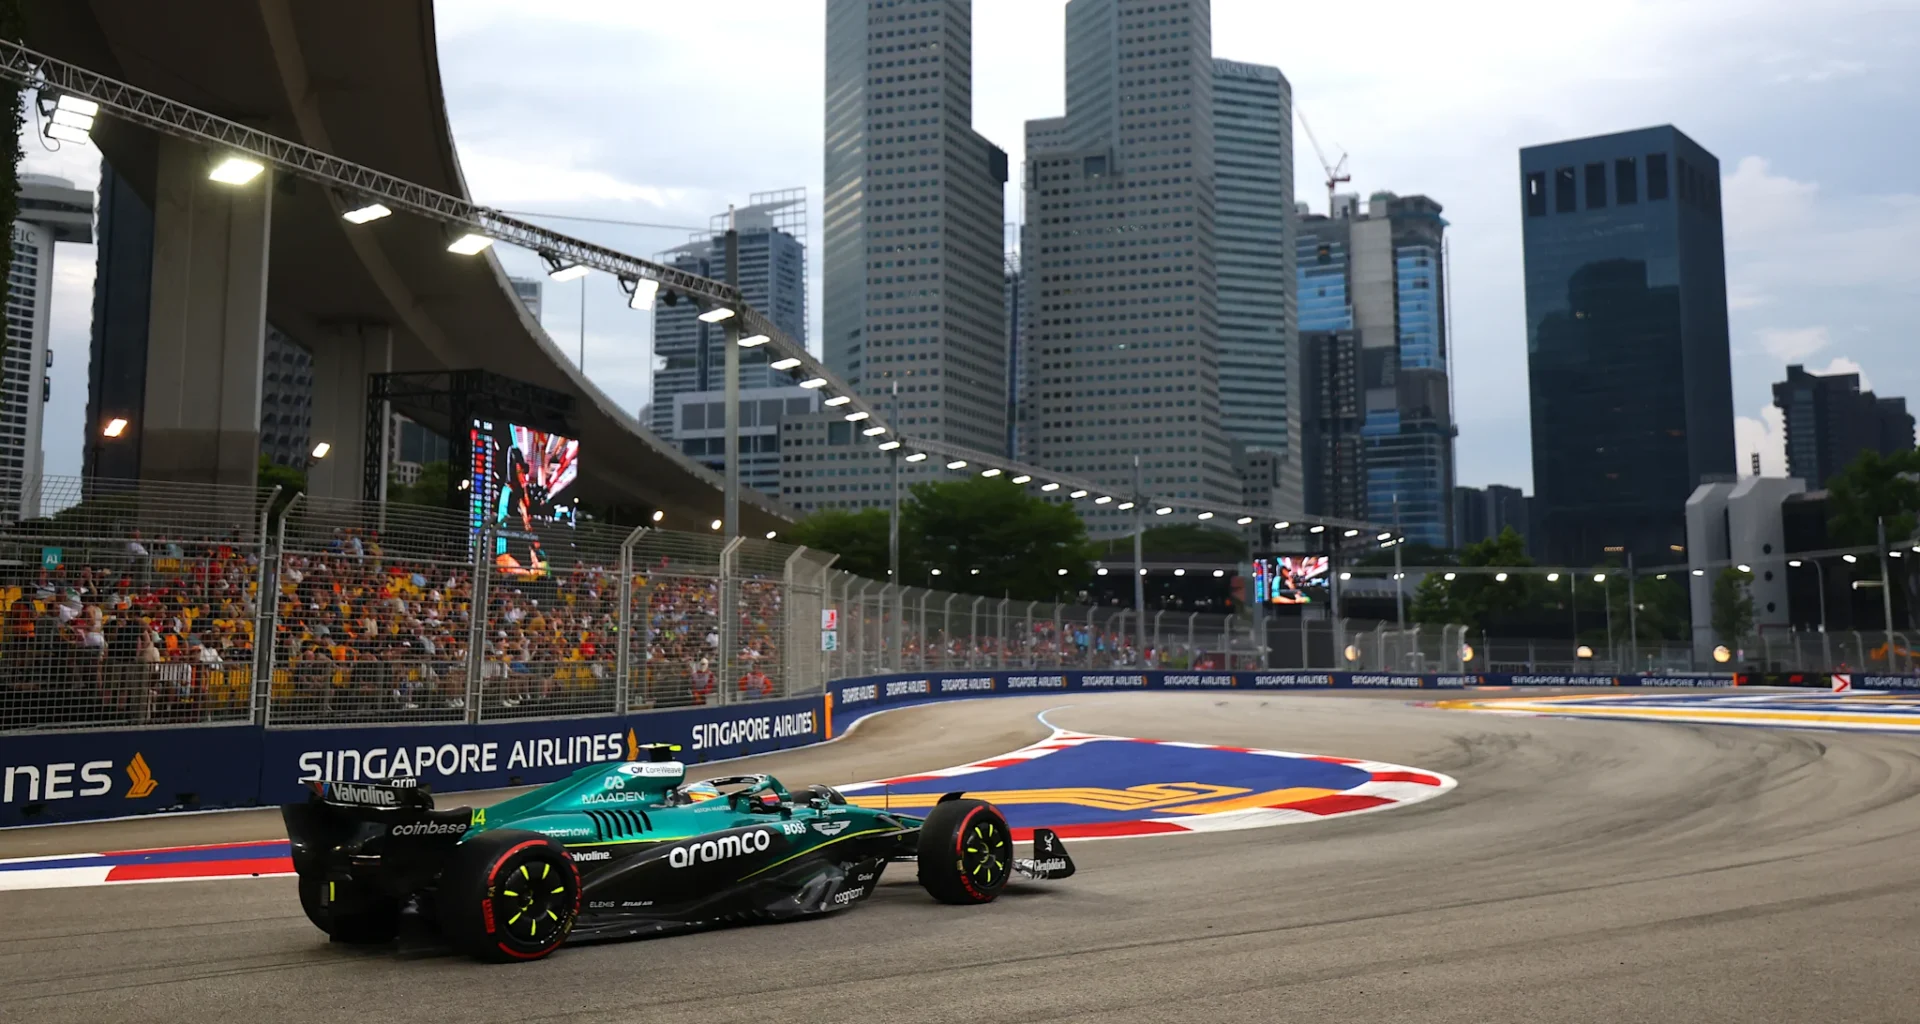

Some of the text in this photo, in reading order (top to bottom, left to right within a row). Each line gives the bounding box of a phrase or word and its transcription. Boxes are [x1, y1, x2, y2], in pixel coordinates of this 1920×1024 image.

[1163, 675, 1230, 686] SINGAPORE AIRLINES
[1255, 674, 1328, 685] SINGAPORE AIRLINES
[1351, 675, 1419, 686] SINGAPORE AIRLINES
[1511, 675, 1612, 685] SINGAPORE AIRLINES
[1641, 677, 1693, 687] SINGAPORE
[692, 711, 812, 750] SINGAPORE AIRLINES
[297, 732, 623, 785] SINGAPORE AIRLINES
[645, 766, 682, 774] CoreWeave
[3, 760, 113, 802] NES
[391, 777, 417, 788] arm
[331, 783, 396, 806] Valvoline
[581, 791, 645, 804] MAADEN
[392, 820, 467, 836] coinbase
[782, 820, 807, 835] BOSS
[669, 829, 770, 869] aramco
[570, 850, 611, 862] alvoline
[834, 885, 865, 905] cognizant
